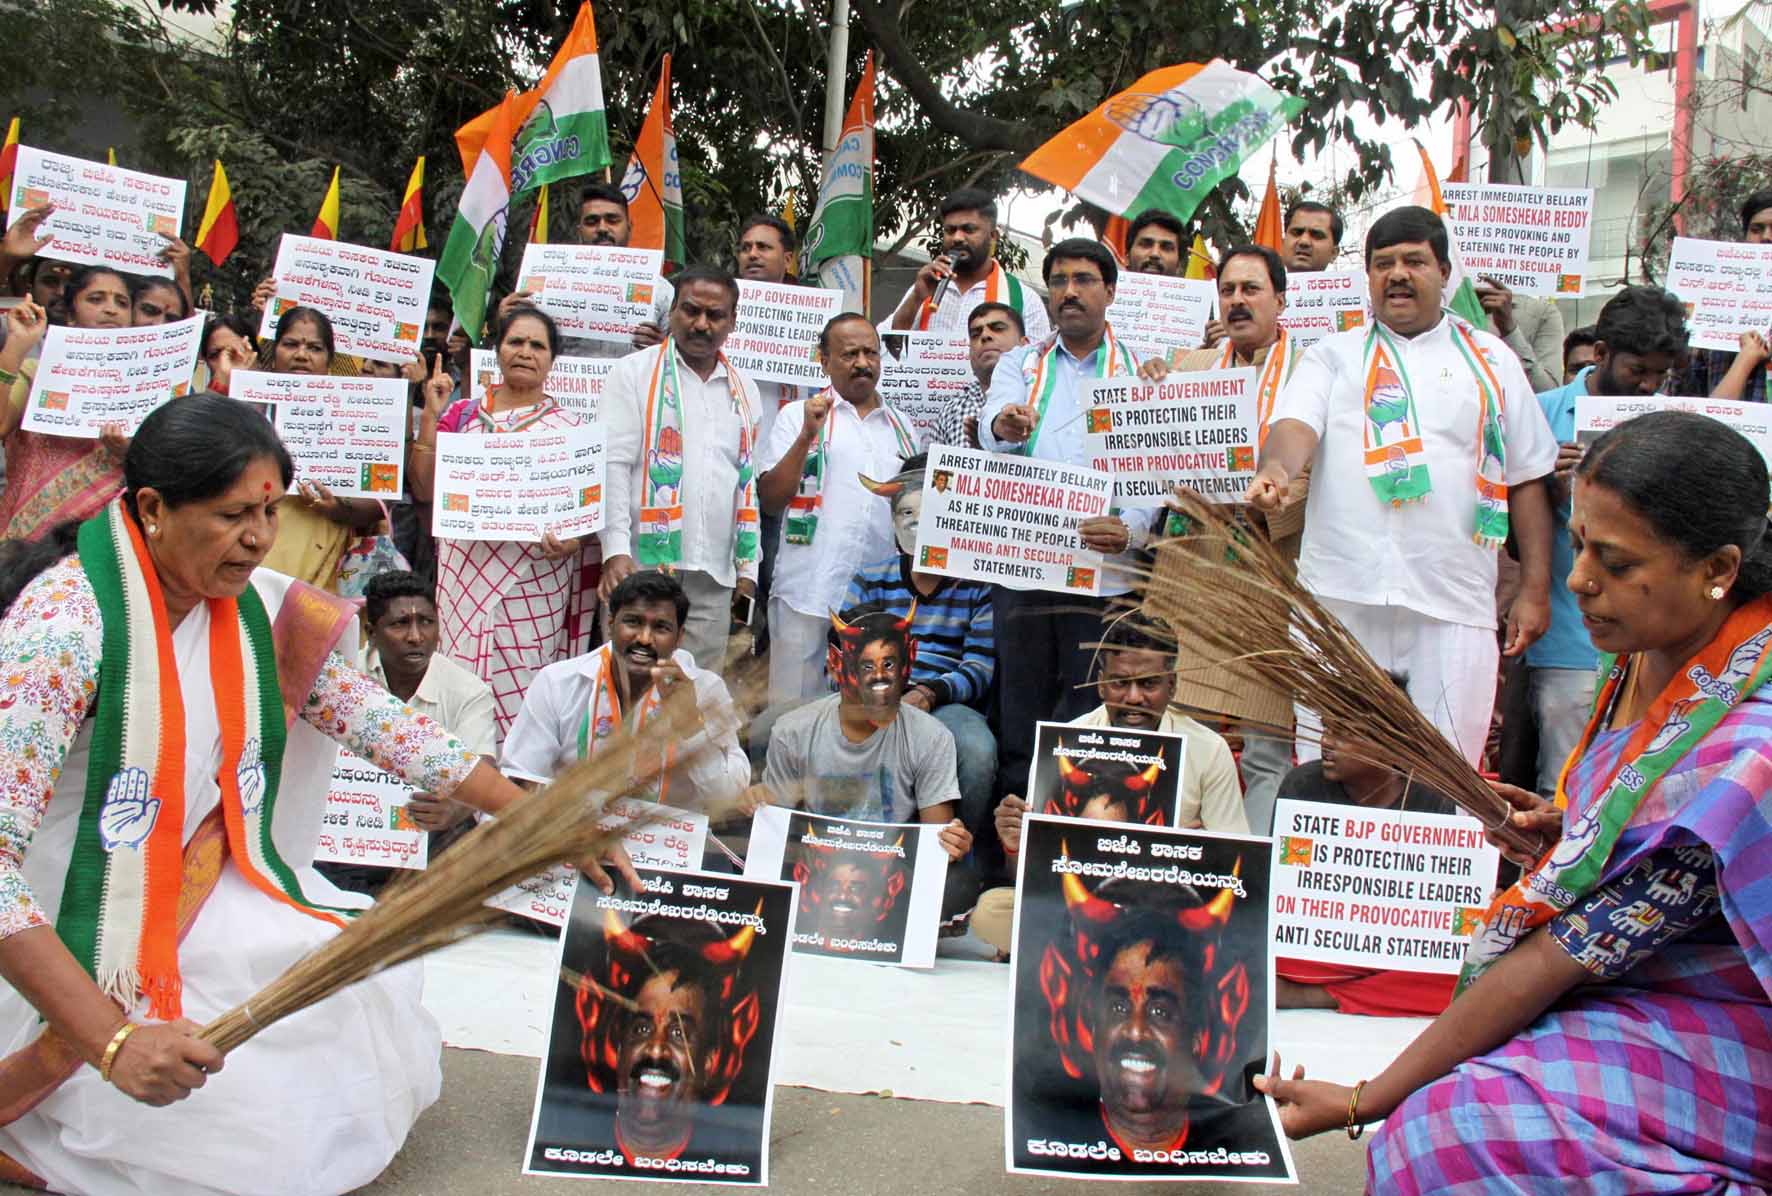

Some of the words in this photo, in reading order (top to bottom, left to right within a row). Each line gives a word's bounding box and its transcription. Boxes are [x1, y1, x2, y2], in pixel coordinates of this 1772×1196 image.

[1443, 190, 1478, 200] ARREST
[1481, 192, 1543, 204] IMMEDIATELY
[1546, 195, 1588, 206] BELLARY
[1458, 205, 1479, 222] MLA
[1483, 206, 1551, 225] SOMESHEKAR
[1554, 212, 1588, 228] REDDY
[1454, 226, 1464, 236] AS
[1467, 227, 1480, 237] HE
[1483, 228, 1492, 237] IS
[1495, 228, 1548, 242] PROVOKING
[1551, 233, 1571, 243] AND
[1457, 242, 1505, 253] EATENING
[1509, 244, 1525, 255] THE
[1529, 247, 1564, 258] PEOPLE
[1567, 249, 1579, 258] BY
[1462, 257, 1493, 267] AKING
[1496, 259, 1516, 269] ANTI
[1520, 261, 1561, 273] SECULAR
[743, 288, 762, 300] BJP
[765, 290, 834, 309] GOVERNMENT
[796, 311, 824, 325] THEIR
[735, 321, 785, 338] SPONSIBLE
[788, 326, 821, 342] LEADE
[725, 337, 740, 349] EIR
[744, 339, 809, 358] PROVOCATIVE
[728, 356, 763, 371] ECULAR
[545, 376, 588, 394] ESHEKAR
[1093, 388, 1127, 405] STATE
[1131, 385, 1154, 401] BJP
[1159, 379, 1246, 400] GOVERNMENT
[1112, 411, 1123, 427] IS
[1126, 406, 1197, 426] PROTECTING
[1201, 404, 1236, 421] THEIR
[1105, 430, 1191, 450] IRRESPONSIBLE
[1195, 427, 1248, 445] LEADERS
[939, 454, 981, 472] ARREST
[984, 459, 1058, 482] IMMEDIATELY
[1060, 471, 1107, 491] BELLARY
[1093, 458, 1108, 473] ON
[1112, 456, 1144, 472] THEIR
[1147, 453, 1225, 471] PROVOCATIVE
[956, 474, 981, 497] MLA
[984, 479, 1064, 509] SOMESHEKAR
[1067, 491, 1106, 516] REDDY
[1114, 482, 1123, 497] TI
[948, 499, 962, 513] AS
[965, 502, 979, 516] HE
[982, 505, 993, 518] IS
[997, 506, 1059, 527] PROVOKING
[936, 516, 1007, 539] THREATENING
[1011, 528, 1031, 542] THE
[1035, 531, 1076, 548] PEOPLE
[1075, 536, 1088, 550] B
[951, 537, 993, 554] MAKING
[995, 543, 1020, 557] ANTI
[1024, 547, 1073, 565] SECULAR
[973, 558, 1045, 580] STATEMENTS.
[1292, 813, 1340, 836] STATE
[1345, 819, 1376, 840] BJP
[1381, 823, 1484, 849] GOVERNMENT
[1096, 836, 1141, 855] ಬಿಜೆಪಿ
[1150, 842, 1203, 861] ಶಾಸಕ
[1314, 844, 1328, 862] IS
[1333, 846, 1425, 872] PROTECTING
[1431, 856, 1472, 876] THEIR
[682, 883, 729, 900] ಶಾಸಕ
[1297, 870, 1415, 899] IRRESPONSIBLE
[1418, 882, 1482, 904] LEADERS
[1275, 895, 1296, 914] ON
[1301, 898, 1344, 920] THEIR
[1350, 903, 1450, 929] PROVOCATIVE
[1275, 925, 1309, 946] ANTI
[1313, 929, 1382, 954] SECULAR
[544, 1147, 625, 1167] ಕೂಡಲೇ
[634, 1156, 751, 1175] ಬಂಧಿಸಬೇಕು
[1026, 1139, 1121, 1161] ಕೂಡಲೇ
[1133, 1148, 1270, 1166] ಬಂಧಿಸಬೇಕು
